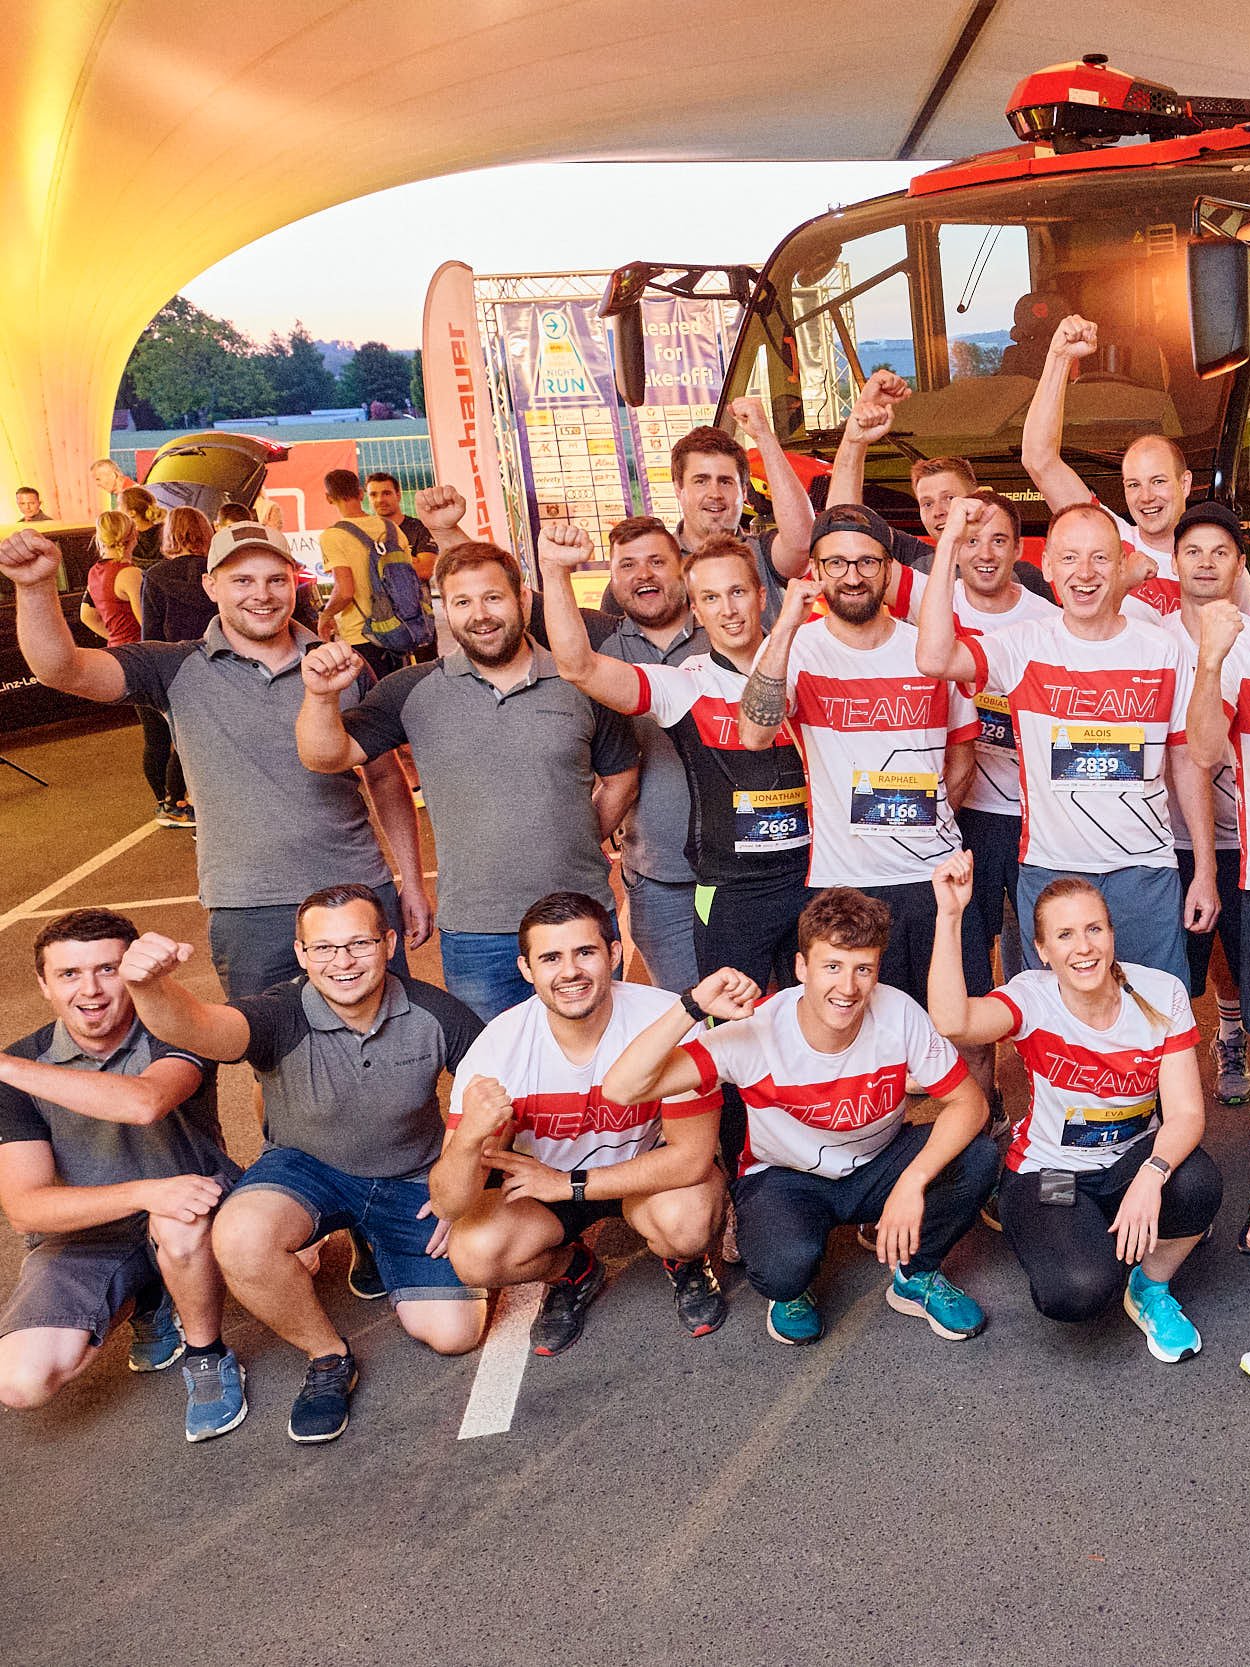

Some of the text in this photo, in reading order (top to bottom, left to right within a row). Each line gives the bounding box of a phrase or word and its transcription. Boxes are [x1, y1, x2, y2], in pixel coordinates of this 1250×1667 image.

[642, 314, 702, 336] leared
[654, 343, 683, 361] for
[645, 366, 714, 387] ake-off!
[543, 378, 585, 393] RUN
[979, 695, 1008, 708] TOBIAS
[1043, 684, 1159, 718] TEAM
[818, 696, 931, 728] TEAM
[1083, 729, 1112, 737] ALOIS
[1076, 757, 1118, 773] 2839
[878, 775, 918, 784] RAPHAEL
[754, 791, 800, 802] JONATHAN
[877, 803, 917, 818] 1166
[759, 817, 797, 835] 2663
[527, 1104, 640, 1138] TEAM
[1100, 1130, 1120, 1142] 11
